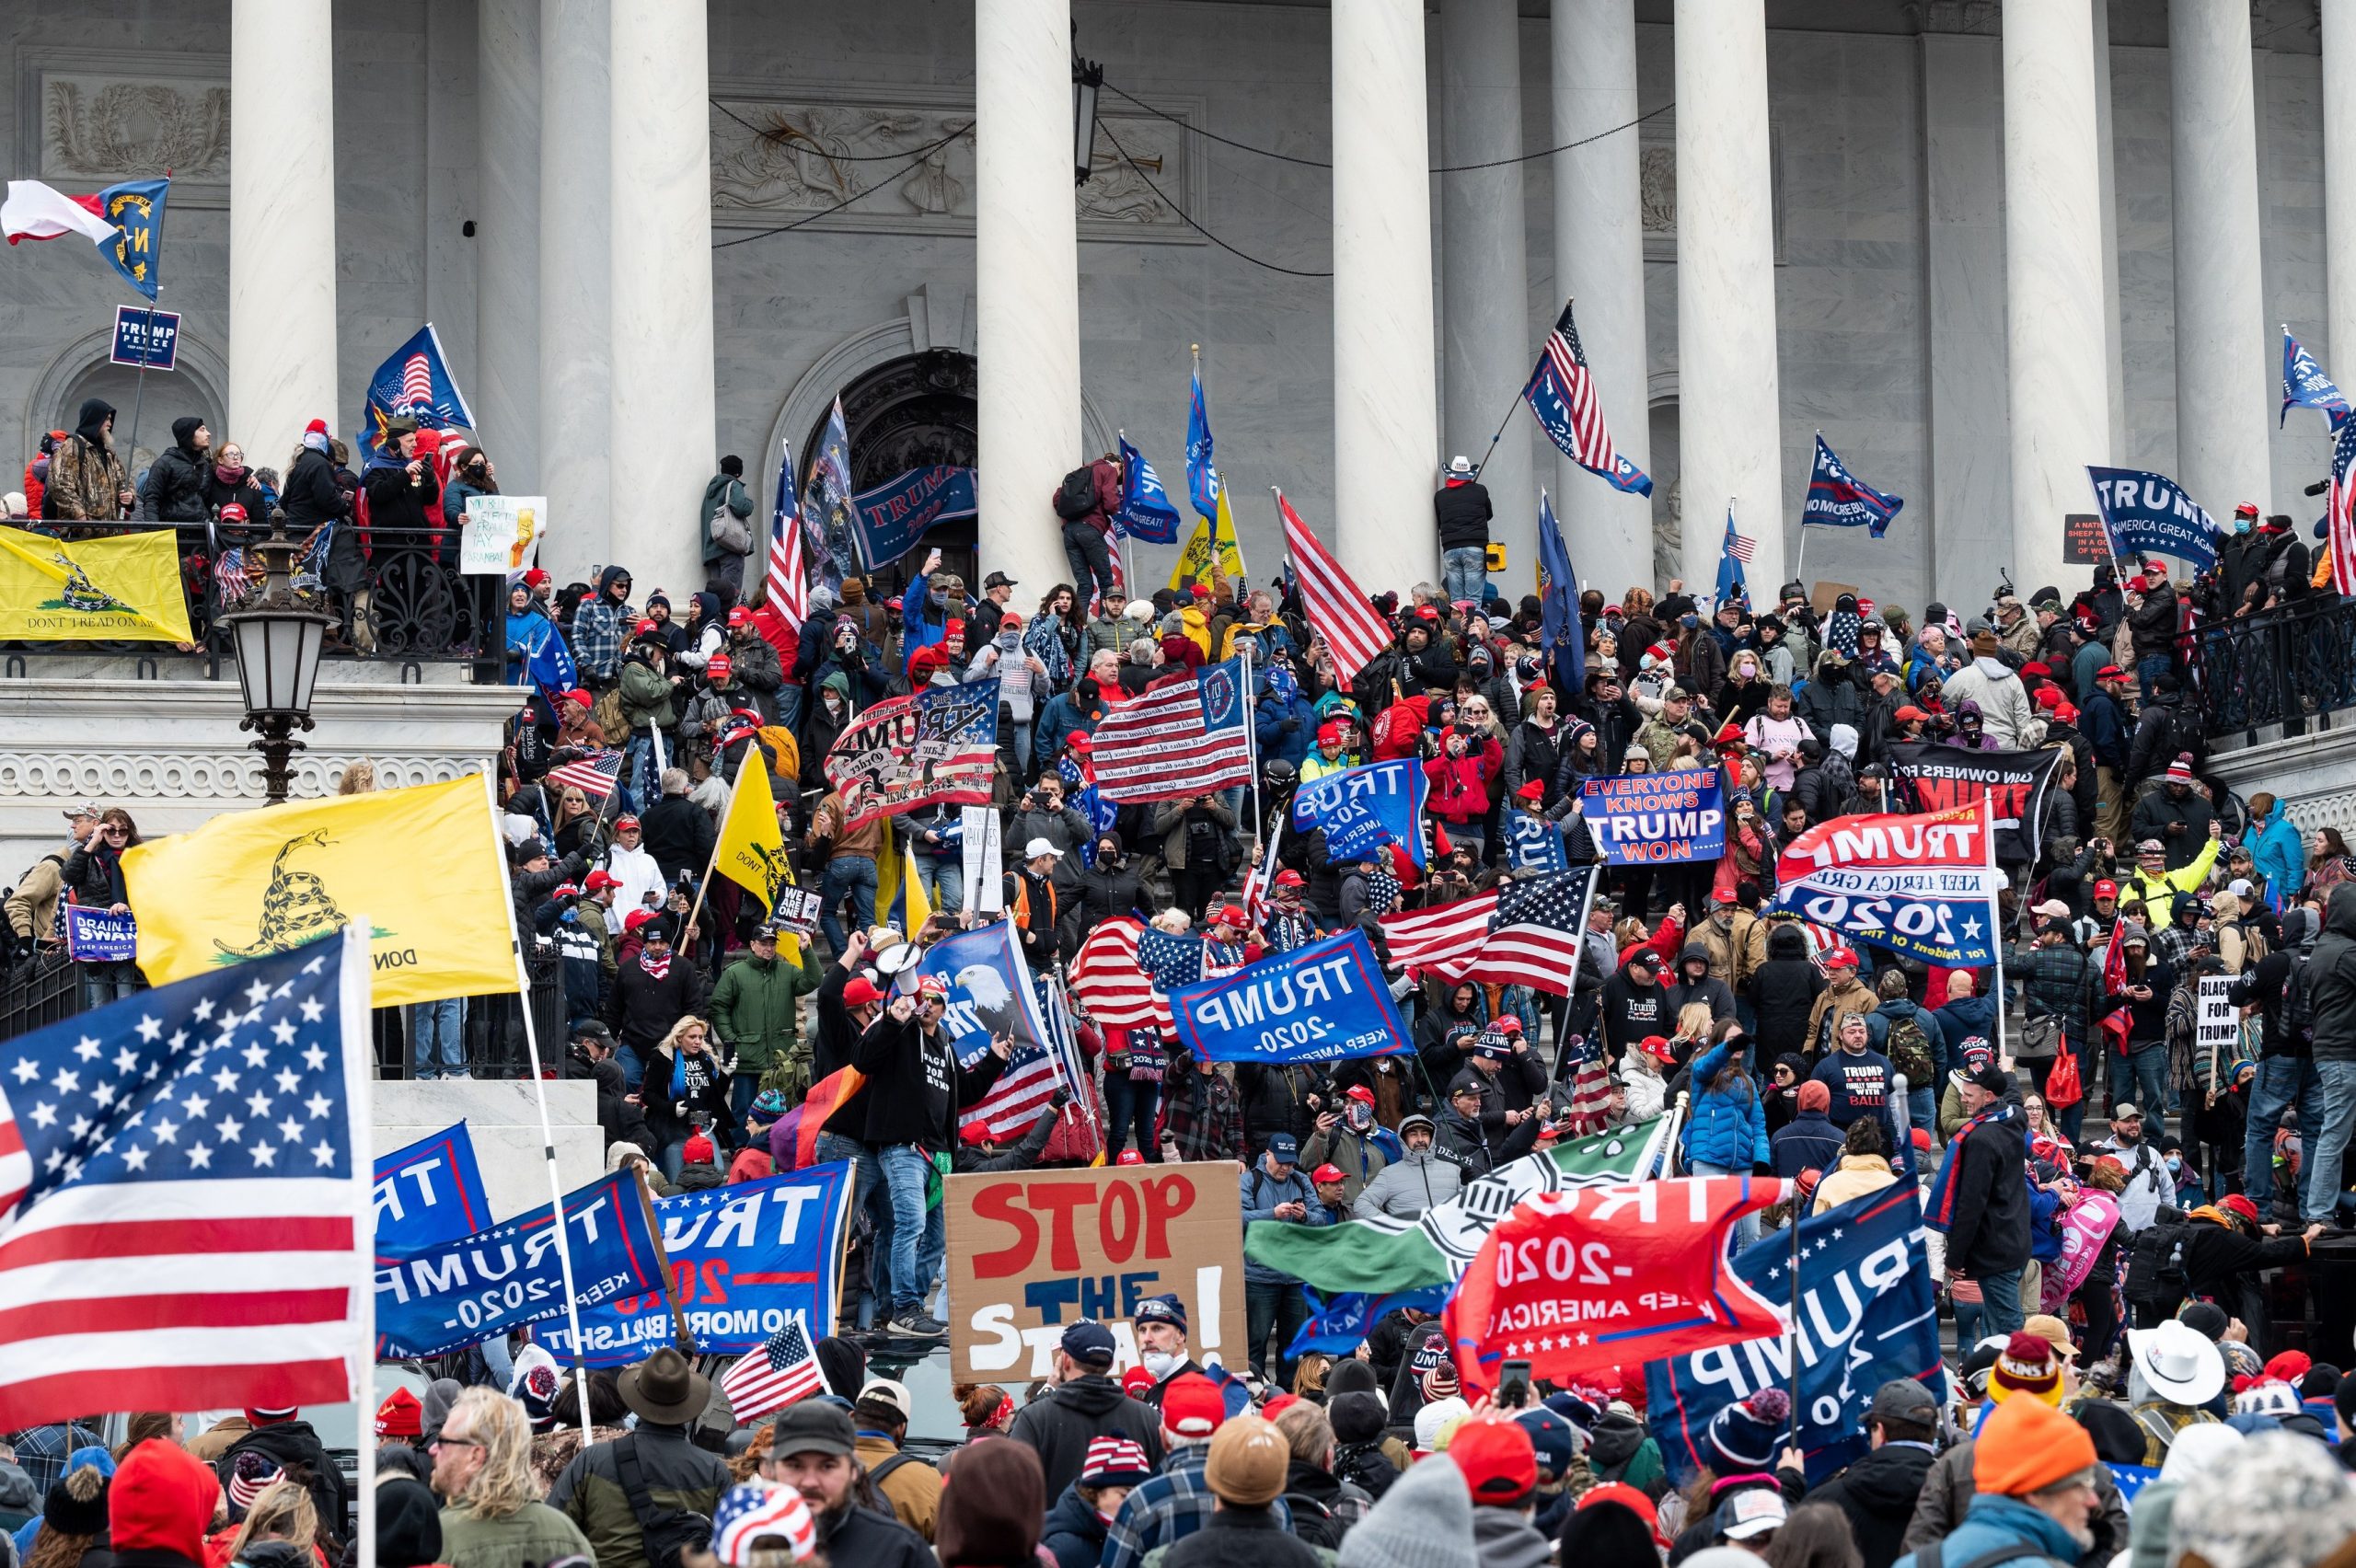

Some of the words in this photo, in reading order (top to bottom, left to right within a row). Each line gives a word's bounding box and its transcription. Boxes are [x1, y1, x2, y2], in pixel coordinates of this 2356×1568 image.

[469, 499, 484, 508] YOU
[1806, 500, 1819, 512] NO
[907, 500, 942, 537] 2020
[2118, 519, 2156, 532] AMERICA
[2158, 523, 2193, 541] GREAT
[28, 617, 64, 628] DONT
[70, 617, 115, 628] TREAD
[117, 616, 138, 628] ON
[140, 619, 157, 628] ME
[526, 726, 536, 760] Berklee
[1585, 771, 1715, 796] EVERYONE
[1605, 791, 1699, 813] KNOWS
[1585, 810, 1721, 842] TRUMP
[1619, 839, 1692, 862] WON
[735, 851, 762, 873] DONT
[785, 886, 804, 902] WE
[778, 906, 800, 919] ONE
[780, 897, 802, 911] ARE
[76, 917, 121, 931] DRAIN
[127, 922, 135, 931] T
[1626, 998, 1657, 1016] Trump
[2207, 1001, 2230, 1018] FOR
[2199, 1024, 2237, 1041] TRUMP
[1133, 1055, 1152, 1064] 2020
[1969, 1053, 1988, 1061] 2020
[926, 1065, 943, 1078] FOR
[1842, 1066, 1884, 1078] TRUMP
[971, 1173, 1196, 1280] STOP
[1024, 1272, 1160, 1325] THE
[969, 1265, 1223, 1378] STA!
